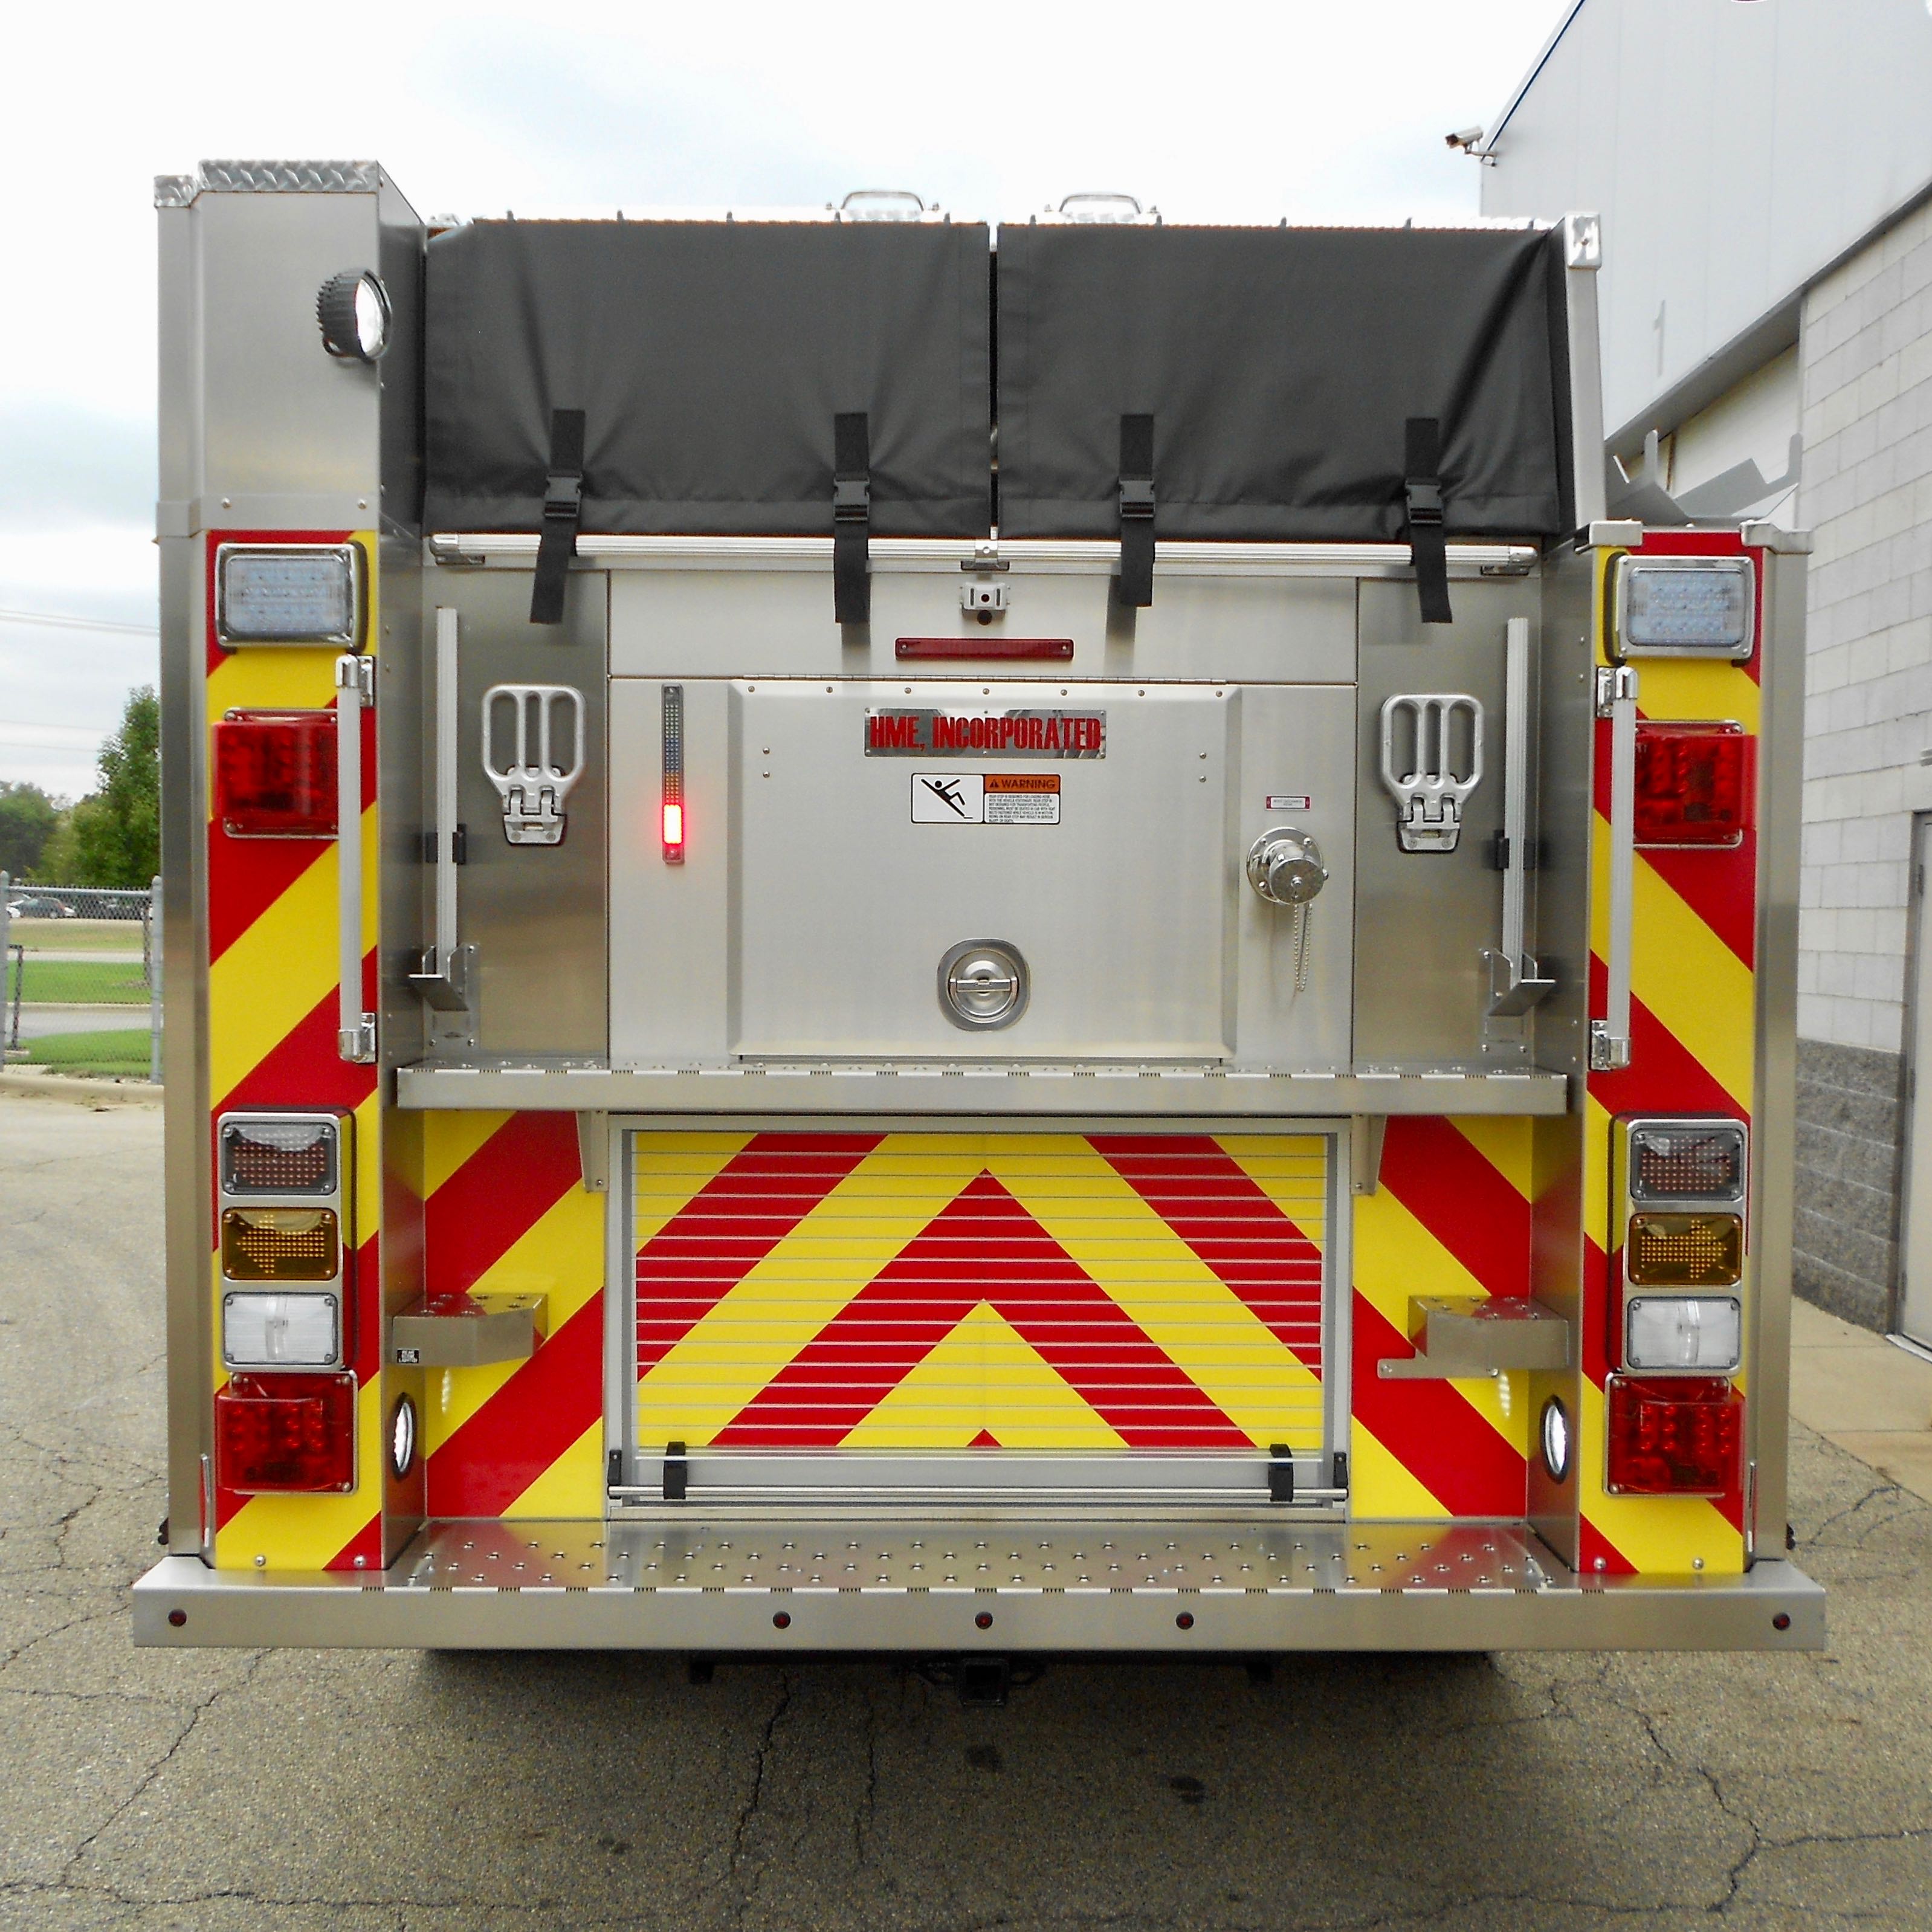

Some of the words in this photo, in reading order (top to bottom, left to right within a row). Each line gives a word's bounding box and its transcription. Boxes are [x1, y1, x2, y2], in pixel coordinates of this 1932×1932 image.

[870, 716, 925, 751] HME,
[932, 717, 1101, 750] INCORPORATED
[1001, 779, 1055, 789] WARNING
